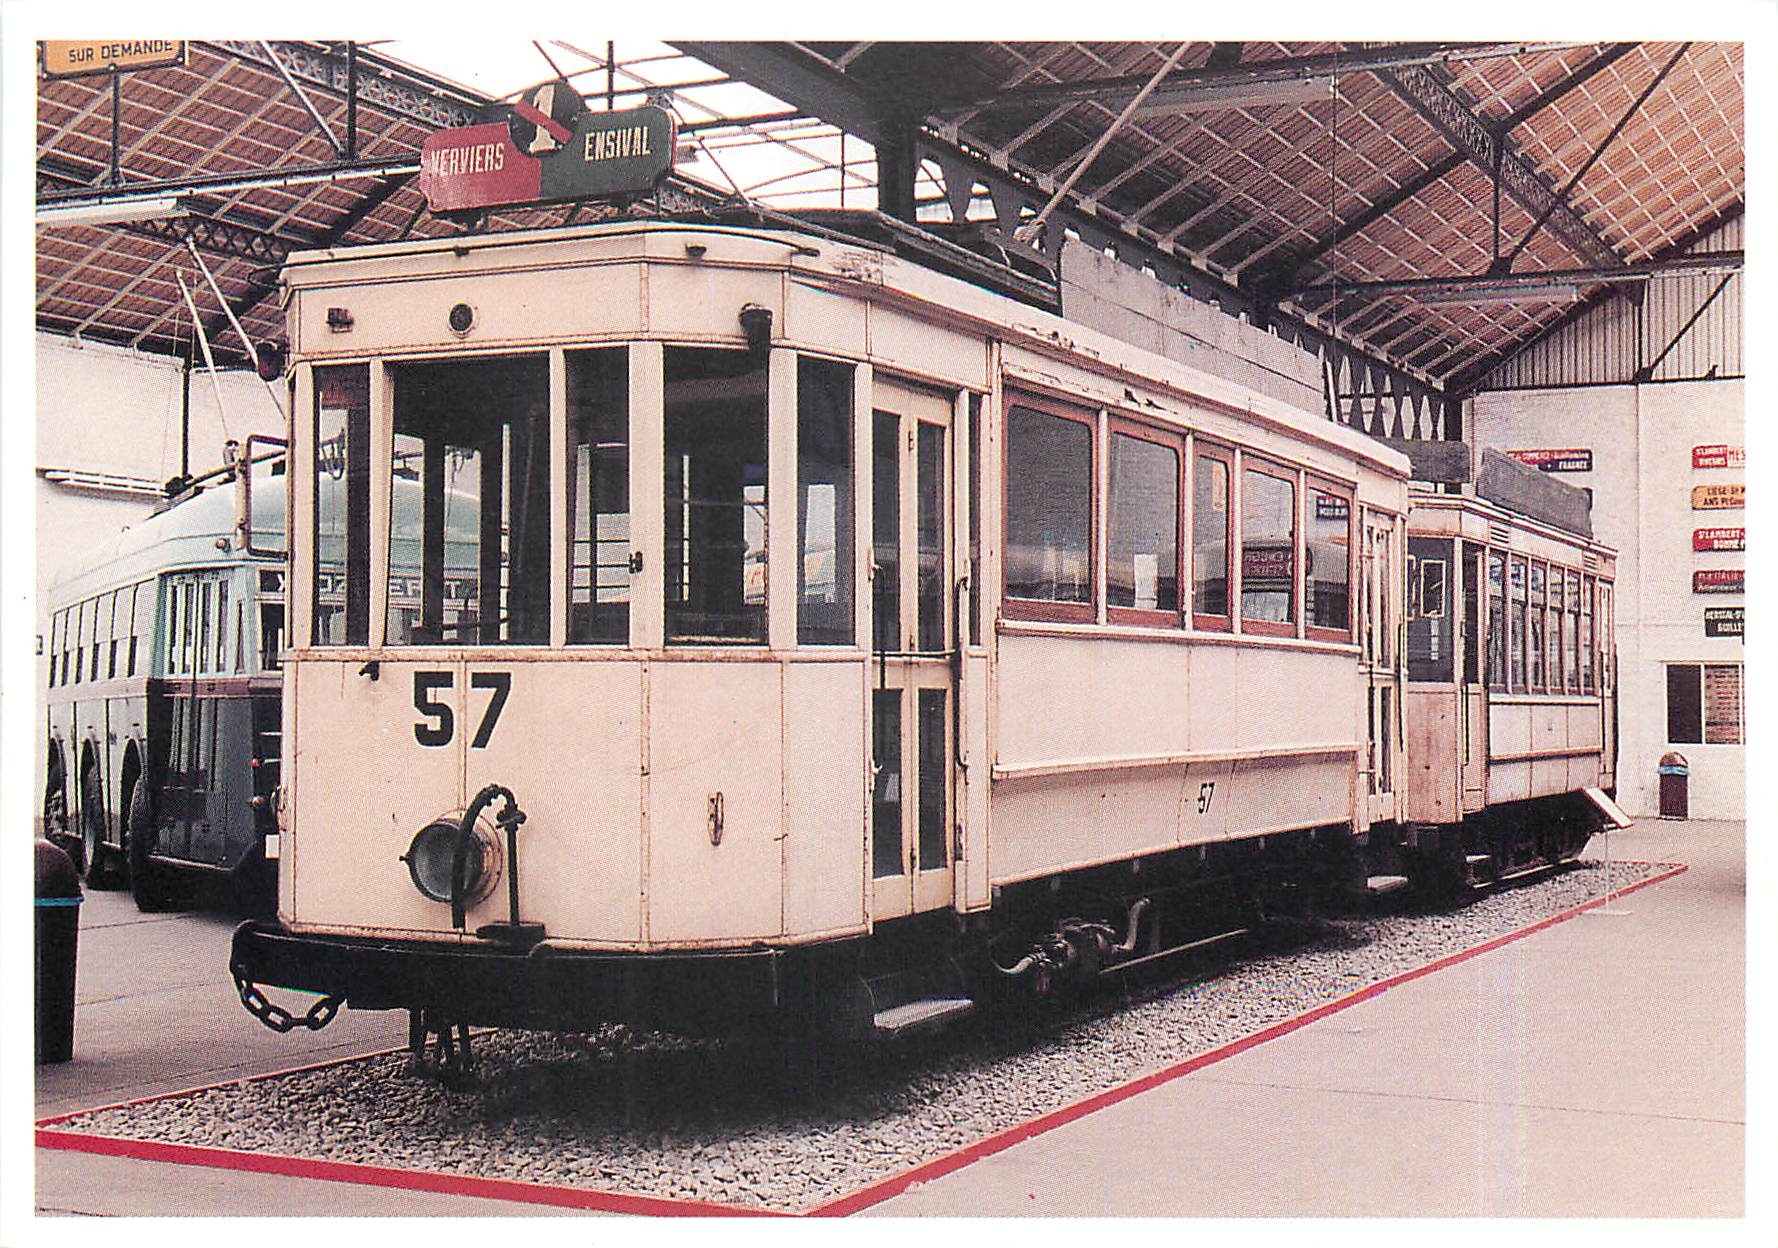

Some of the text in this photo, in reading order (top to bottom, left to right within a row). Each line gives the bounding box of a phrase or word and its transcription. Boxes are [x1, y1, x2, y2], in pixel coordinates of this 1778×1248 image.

[69, 39, 173, 63] SUR DEMANDE
[428, 142, 505, 177] VERVIERS
[584, 126, 652, 162] ENSIVAL
[413, 671, 512, 749] 57
[1197, 782, 1215, 814] 57
